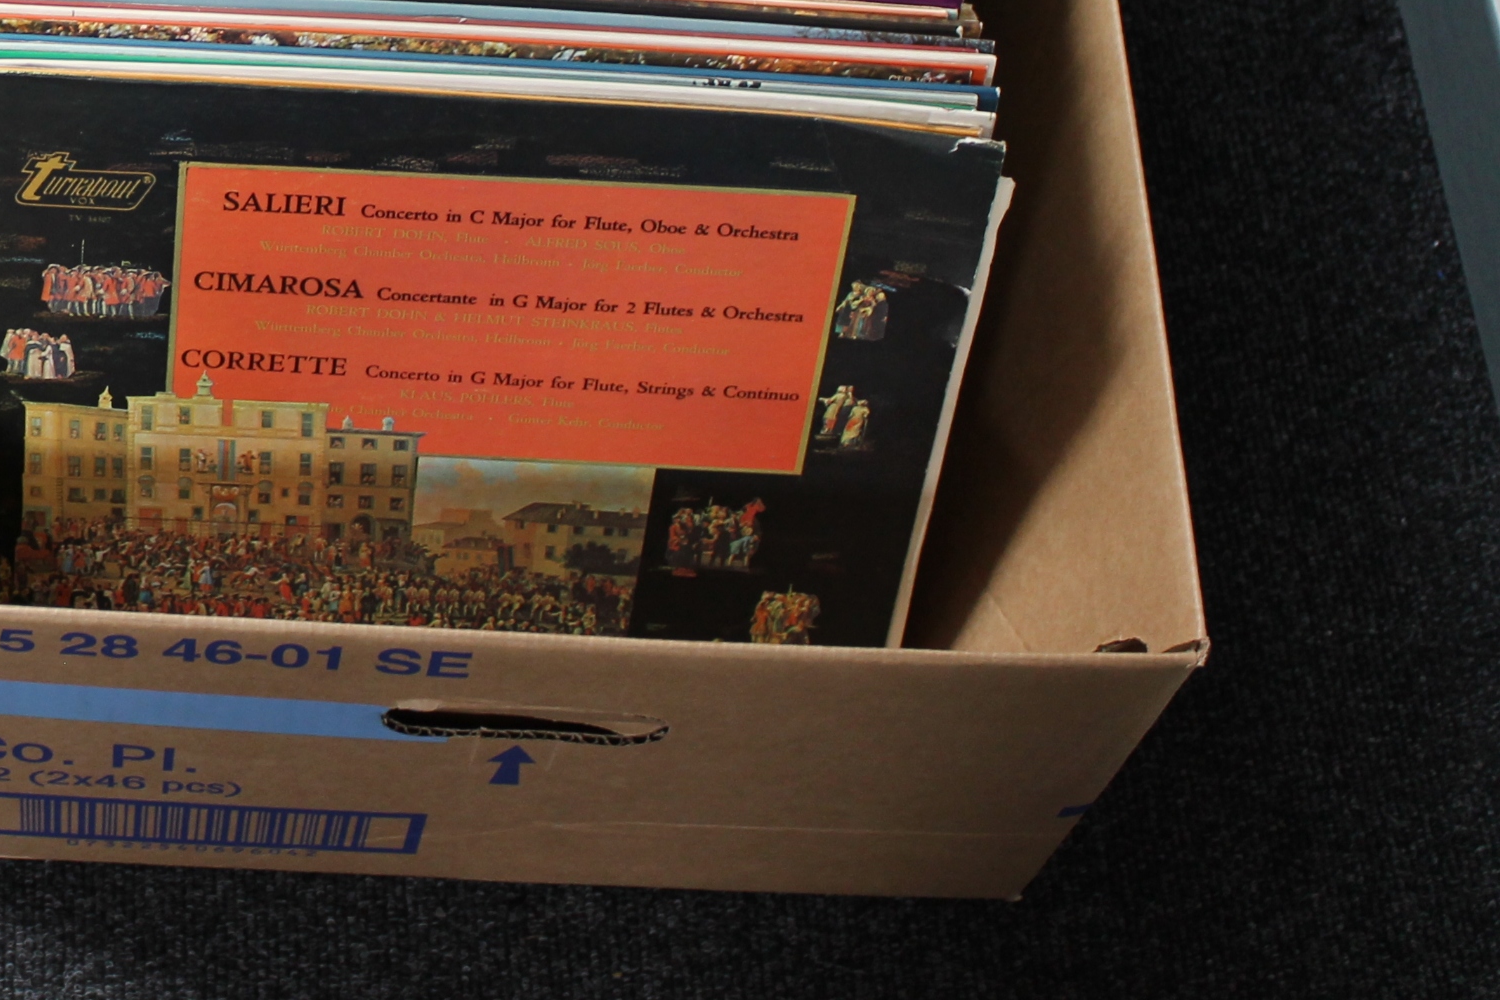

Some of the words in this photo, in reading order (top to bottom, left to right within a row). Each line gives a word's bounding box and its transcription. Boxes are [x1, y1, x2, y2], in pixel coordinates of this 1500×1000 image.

[69, 196, 96, 206] VOX
[222, 190, 347, 218] SALIERI
[360, 203, 439, 223] Concerto
[445, 207, 462, 223] in
[468, 208, 485, 225] C
[491, 209, 545, 231] Major
[551, 212, 577, 231] for
[583, 214, 633, 235] Flute,
[639, 217, 688, 237] Oboe
[694, 222, 711, 237] &
[715, 222, 801, 243] Orchestra
[320, 223, 386, 239] ROBERT
[455, 231, 490, 244] Flute
[524, 236, 588, 251] ALFRED
[648, 243, 687, 255] Oboe
[352, 245, 413, 260] Chamber
[493, 252, 561, 268] Heilbronn
[674, 263, 745, 278] Conductor
[193, 269, 364, 300] CIMAROSA
[375, 285, 478, 306] Concertante
[488, 291, 505, 307] in
[511, 292, 529, 308] G
[534, 294, 588, 316] Major
[593, 296, 618, 315] for
[625, 301, 637, 315] 2
[643, 301, 694, 319] Flutes
[700, 305, 717, 320] &
[721, 305, 804, 324] Orchestra
[306, 303, 371, 318] ROBERT
[376, 308, 428, 322] DOHN
[434, 311, 446, 322] &
[453, 312, 524, 326] HELMUT
[644, 322, 683, 335] Flutes
[347, 325, 406, 339] Chamber
[484, 332, 552, 347] Heilbronn
[662, 342, 730, 356] Conductor
[181, 347, 348, 378] CORRETTE
[364, 363, 440, 383] Concerto
[446, 368, 464, 384] in
[469, 369, 487, 386] G
[492, 371, 545, 393] Major
[550, 375, 575, 392] for
[581, 376, 631, 398] Flute,
[636, 379, 695, 401] Strings
[700, 385, 717, 400] &
[722, 385, 801, 403] Continuo
[59, 631, 140, 659] 28
[162, 637, 345, 672] 46-01
[373, 648, 474, 680] SE
[27, 767, 148, 792] (2x46
[160, 774, 243, 799] pcs)
